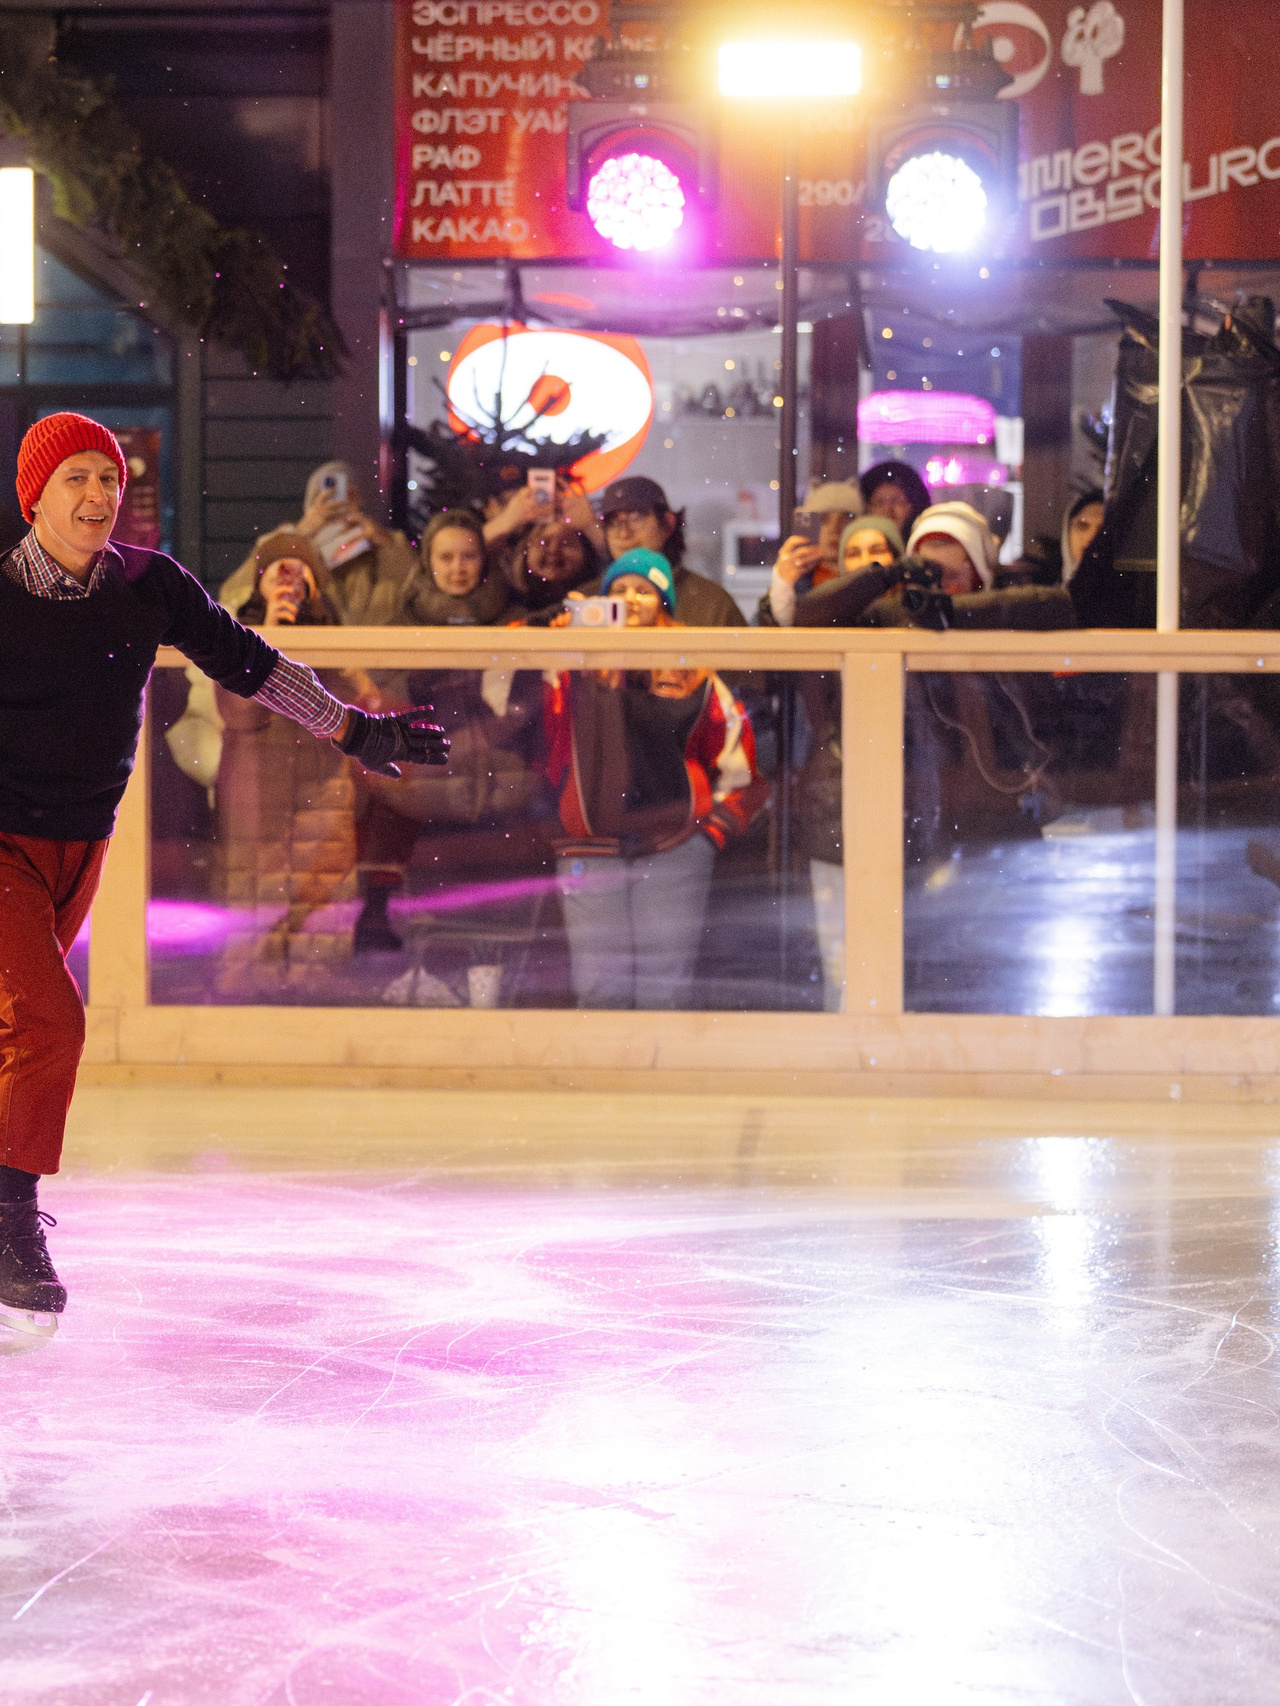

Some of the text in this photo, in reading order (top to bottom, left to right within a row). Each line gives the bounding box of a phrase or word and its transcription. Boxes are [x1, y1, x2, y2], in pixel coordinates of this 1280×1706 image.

[412, 0, 599, 26] ЭСПРЕССО
[411, 31, 556, 62] ЧЁРНЫЙ
[412, 72, 592, 98] КАПУЧИН
[411, 108, 505, 134] ФЛЭТ
[412, 144, 482, 170] РАФ
[411, 179, 516, 207] ЛАТТЕ
[412, 217, 529, 243] КАКАО
